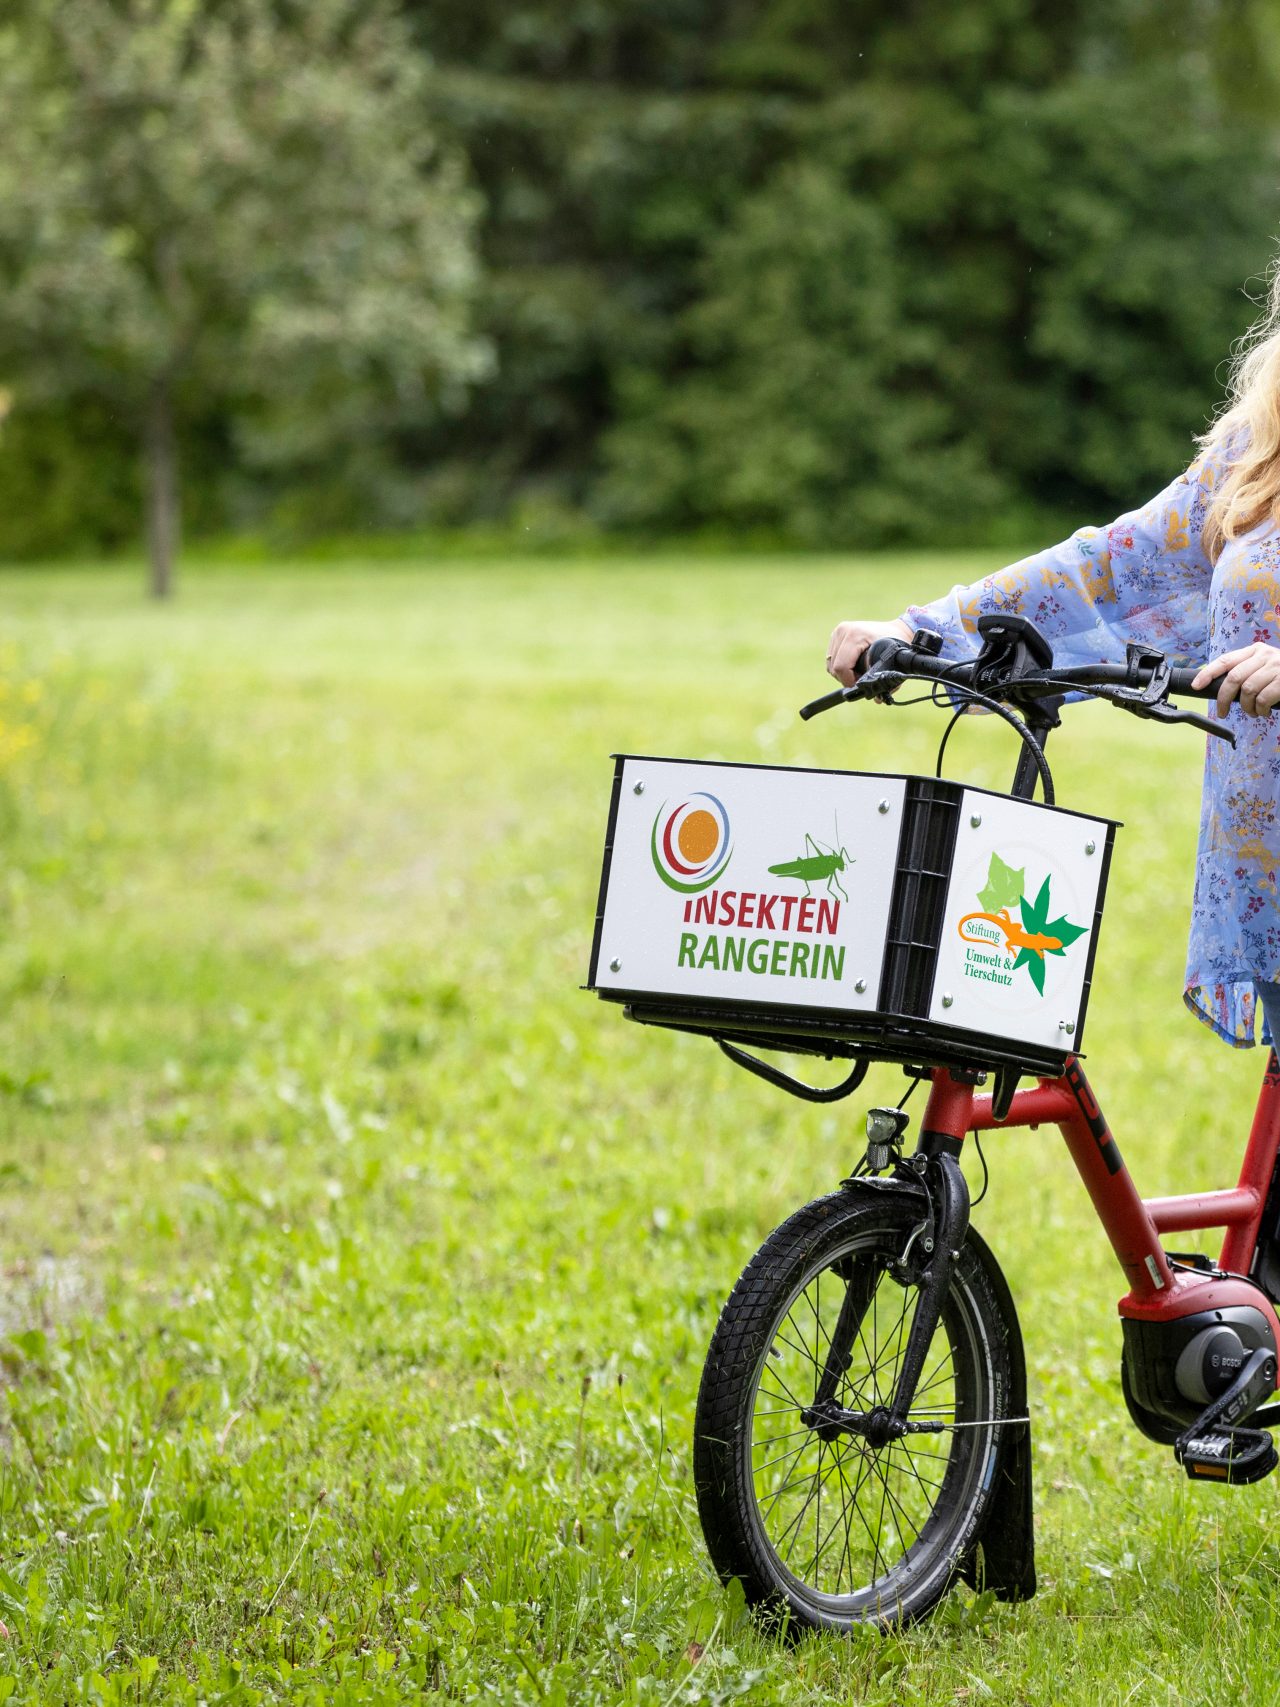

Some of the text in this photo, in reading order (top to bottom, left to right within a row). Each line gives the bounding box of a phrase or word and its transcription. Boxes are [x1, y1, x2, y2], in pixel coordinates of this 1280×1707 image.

[683, 890, 841, 935] INSEKTEN
[966, 921, 1000, 943] Stiftung
[677, 932, 846, 981] RANGERIN
[966, 948, 1013, 970] Umwelt &
[964, 962, 1013, 986] Tierschutz
[1221, 1357, 1241, 1368] BOSCH
[993, 1371, 1002, 1442] SCHWALBE
